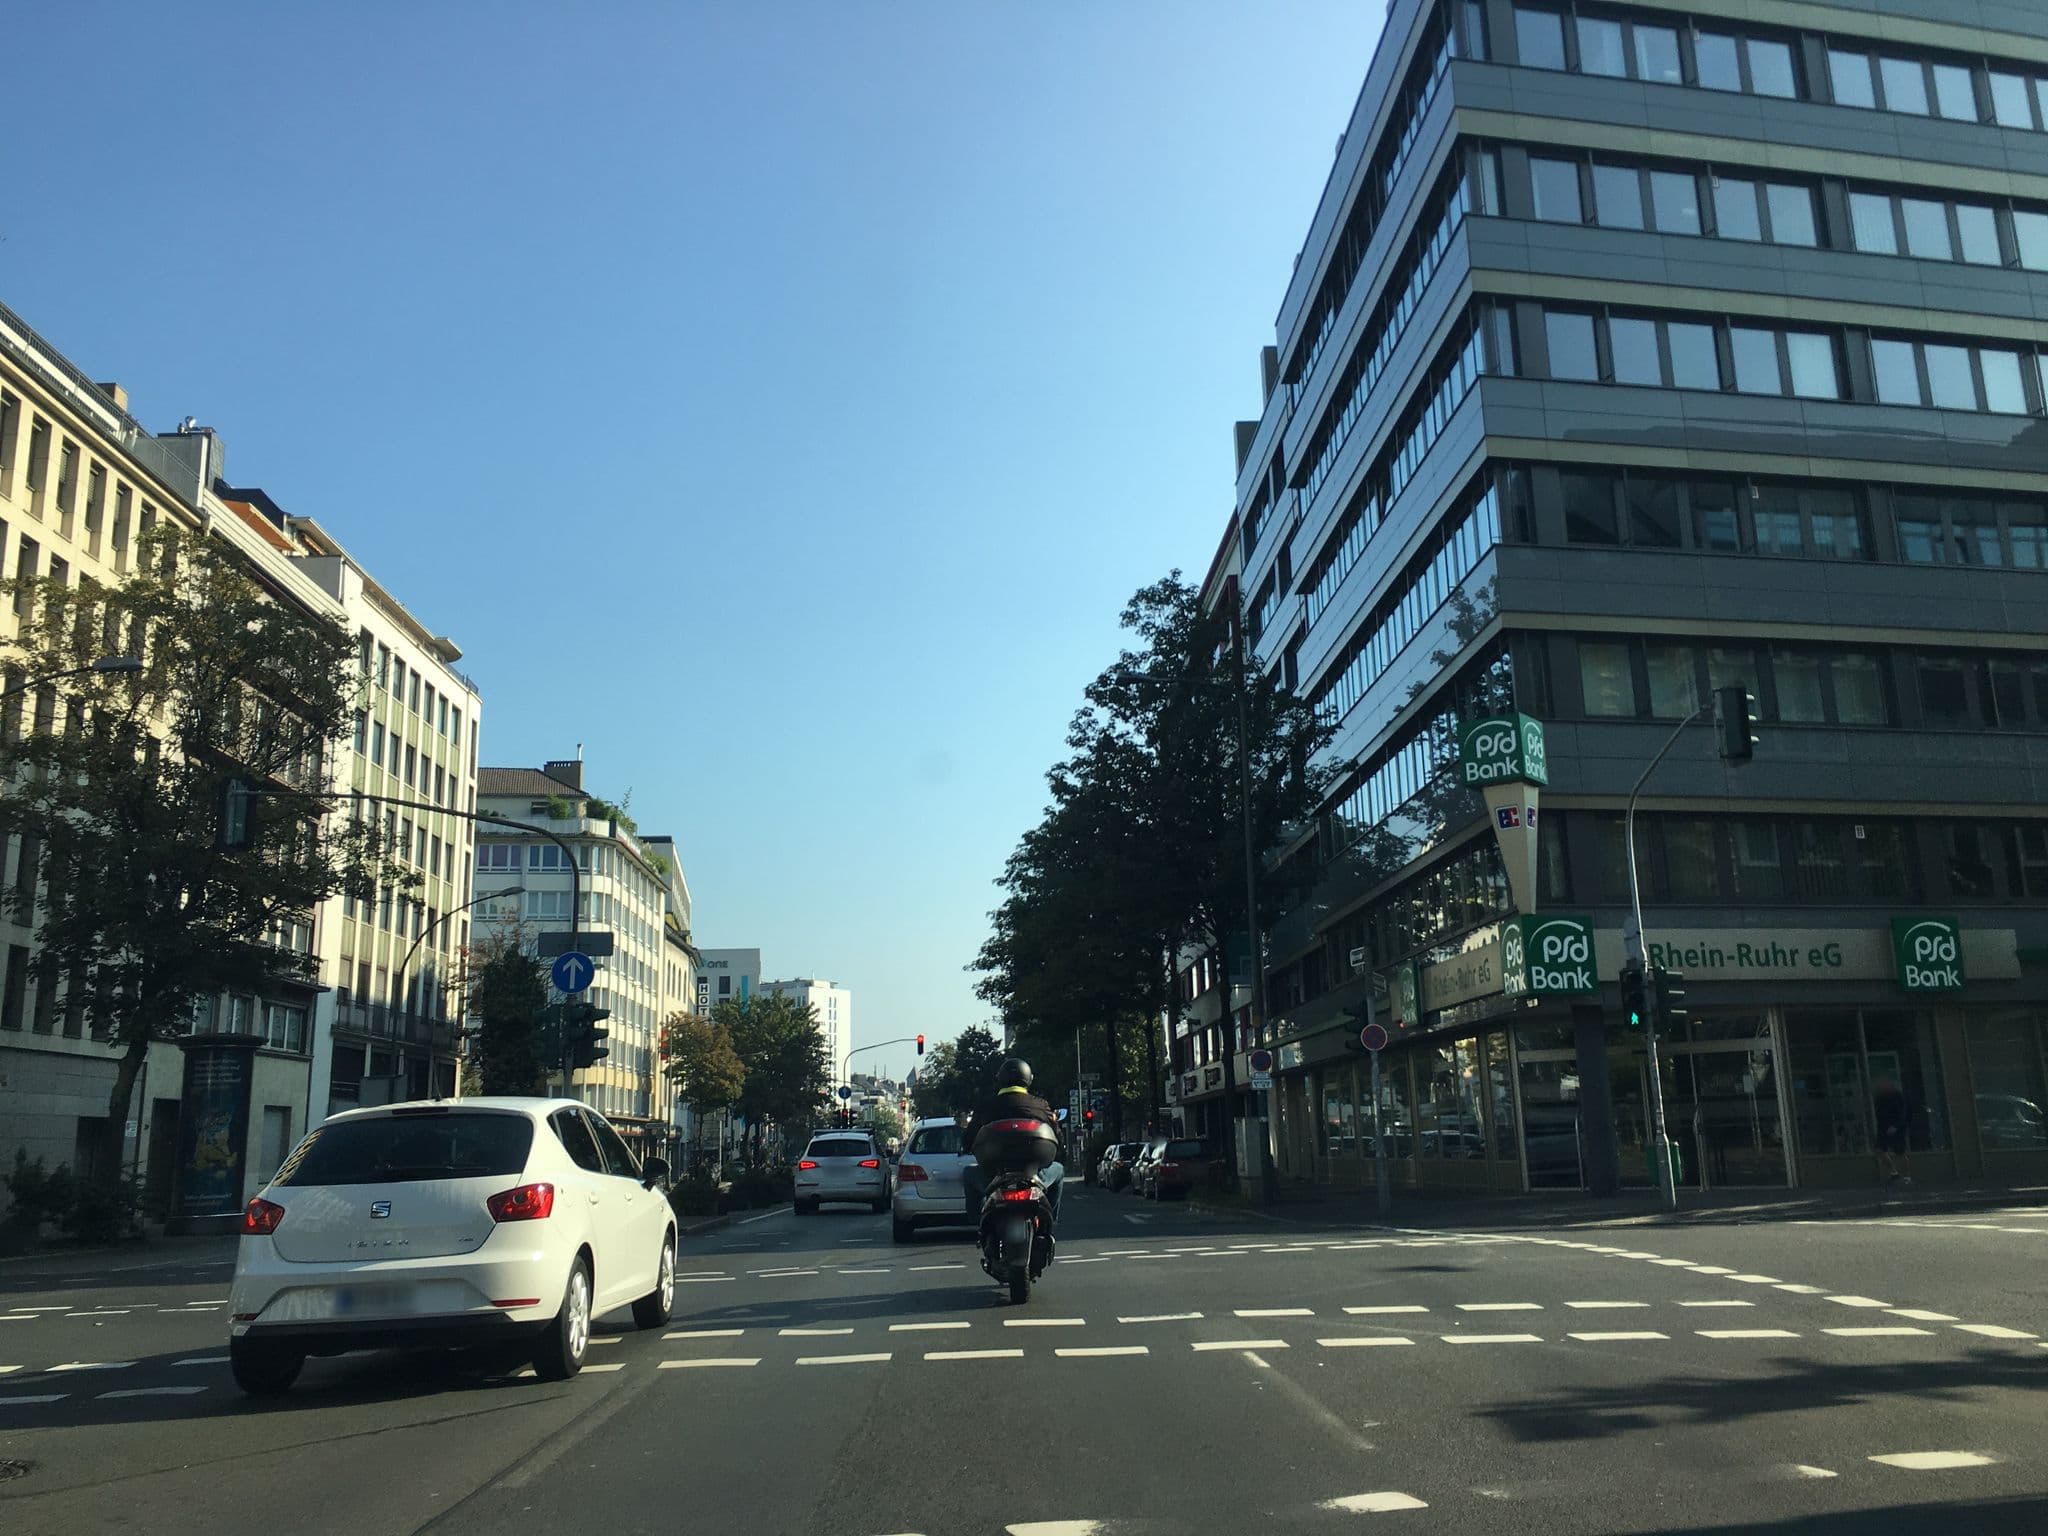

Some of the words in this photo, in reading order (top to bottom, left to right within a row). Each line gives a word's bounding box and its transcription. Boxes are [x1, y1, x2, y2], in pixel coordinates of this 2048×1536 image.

[1465, 757, 1520, 782] Bank
[1525, 755, 1547, 781] Bank
[1648, 941, 1799, 968] Rhein-Ruhr
[1807, 942, 1842, 967] eG
[1503, 968, 1527, 994] Bank
[1531, 965, 1593, 990] Bank
[1905, 964, 1962, 988] Bank
[700, 984, 708, 1017] HOT
